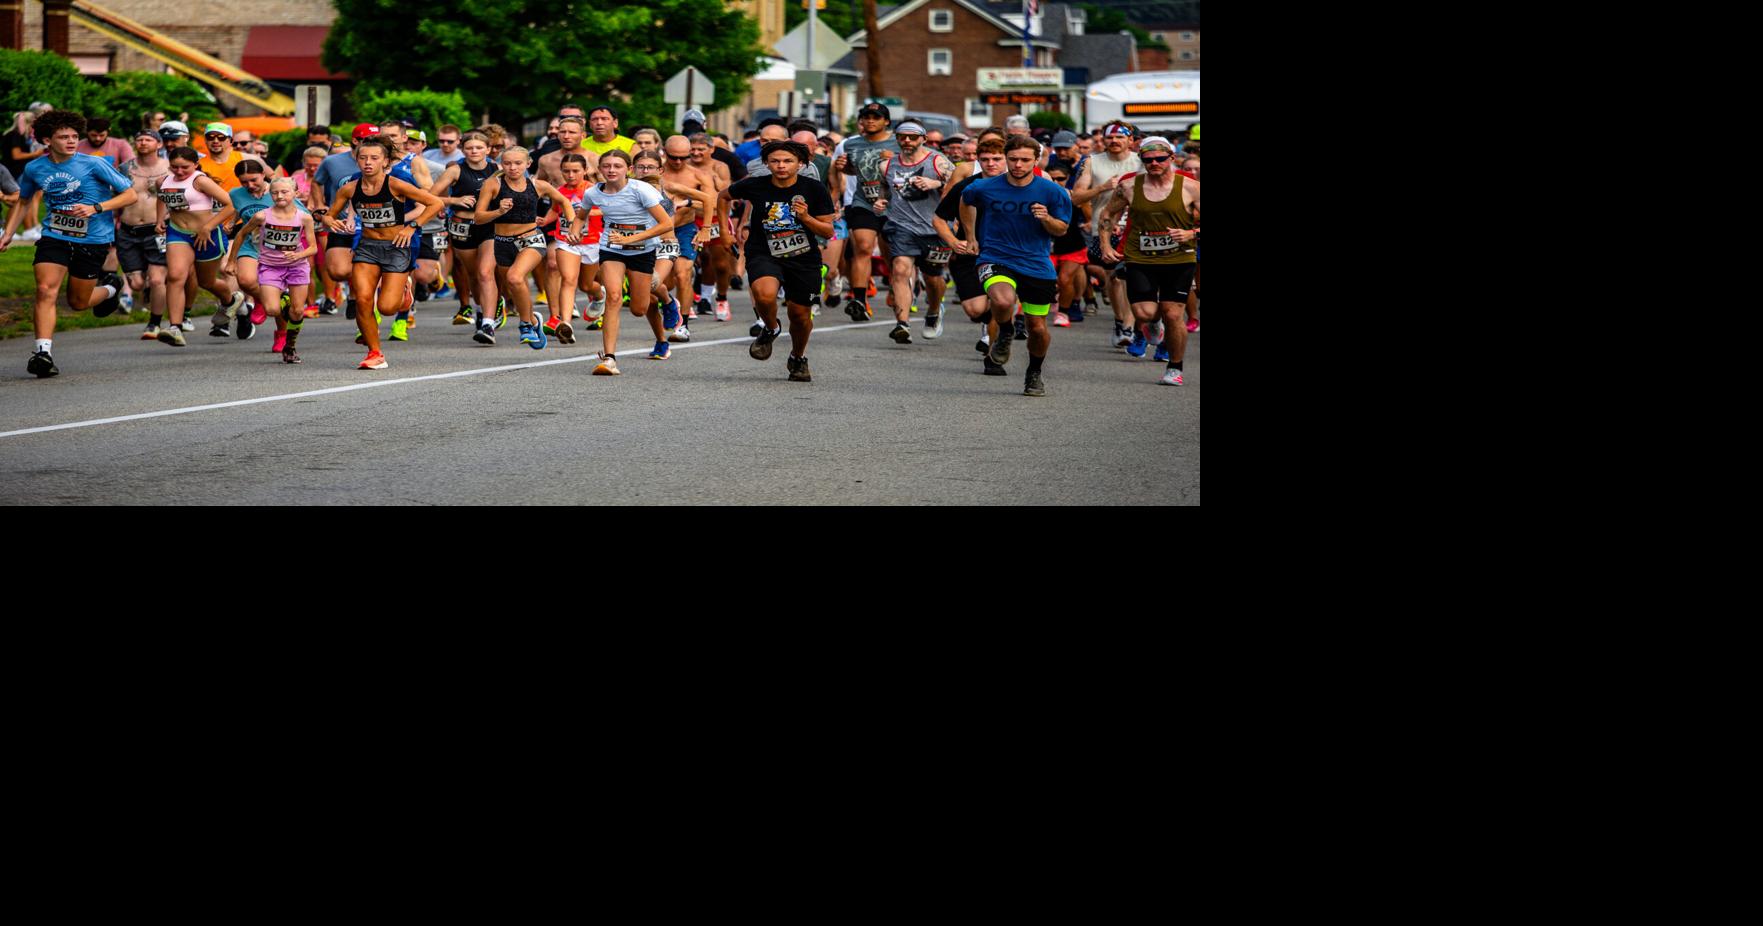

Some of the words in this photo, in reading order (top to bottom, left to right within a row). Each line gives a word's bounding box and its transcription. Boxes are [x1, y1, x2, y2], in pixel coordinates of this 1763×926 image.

[160, 194, 184, 204] 2055
[360, 209, 391, 220] 2024
[54, 214, 85, 229] 2090
[266, 231, 297, 242] 2037
[1143, 236, 1176, 247] 2132
[772, 235, 804, 251] 2146
